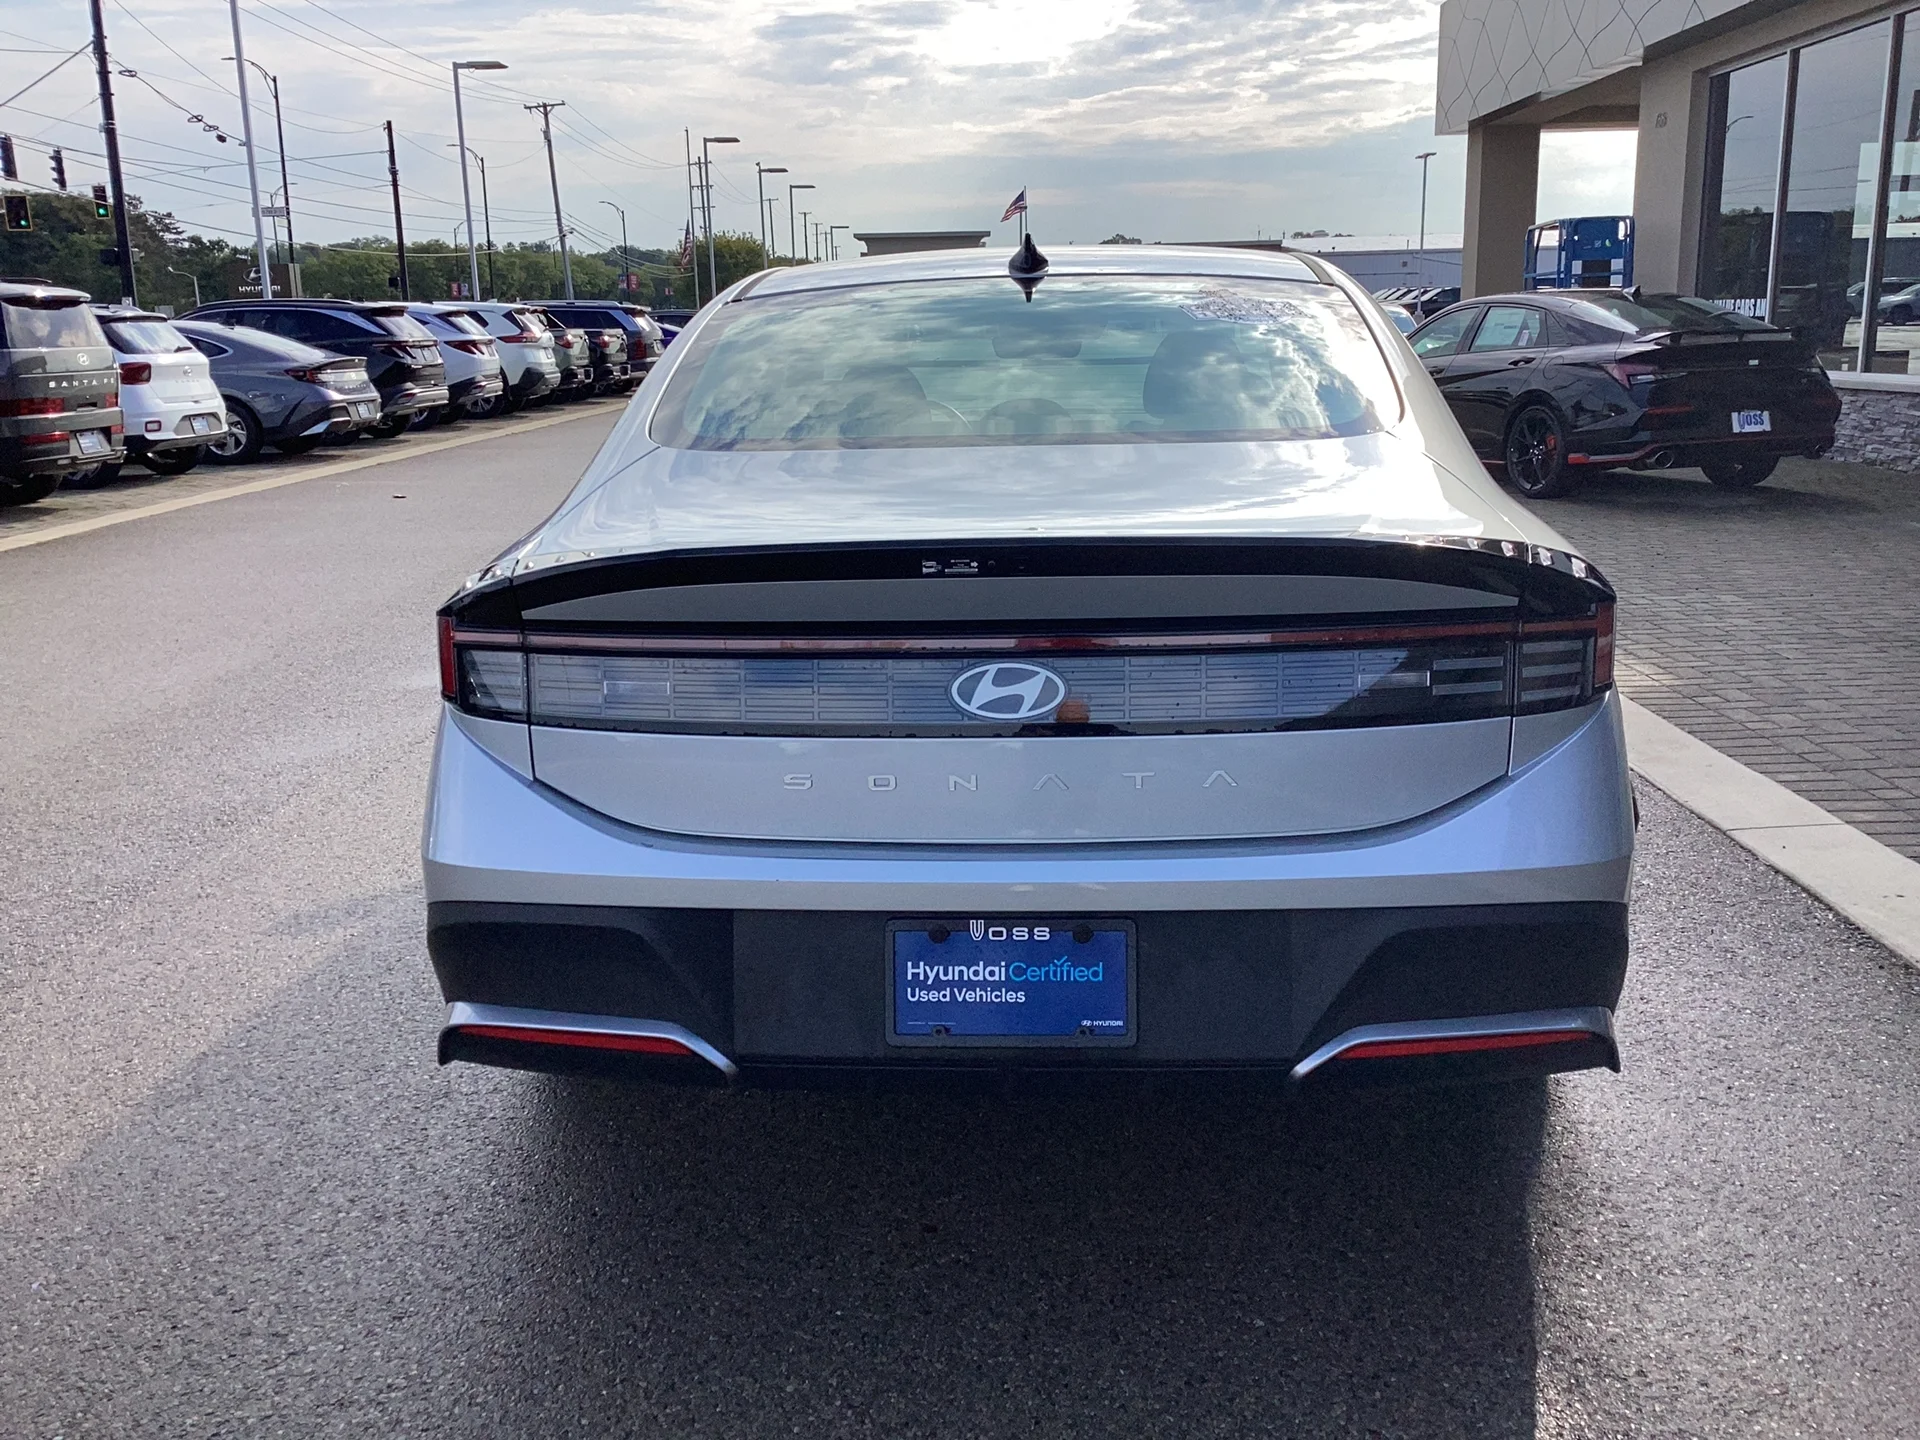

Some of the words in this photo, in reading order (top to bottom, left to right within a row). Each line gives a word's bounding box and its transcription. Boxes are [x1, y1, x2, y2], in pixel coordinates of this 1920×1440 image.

[238, 285, 281, 293] HYUNAI
[1735, 299, 1755, 317] CARS
[49, 380, 98, 388] SANTA
[1738, 411, 1765, 430] VOSS
[783, 770, 1239, 792] SONATA
[970, 920, 1050, 941] VOSS
[906, 961, 1006, 984] Hyundai
[1009, 956, 1103, 982] Certified
[907, 988, 951, 1002] Used
[953, 987, 1026, 1003] Vehicles
